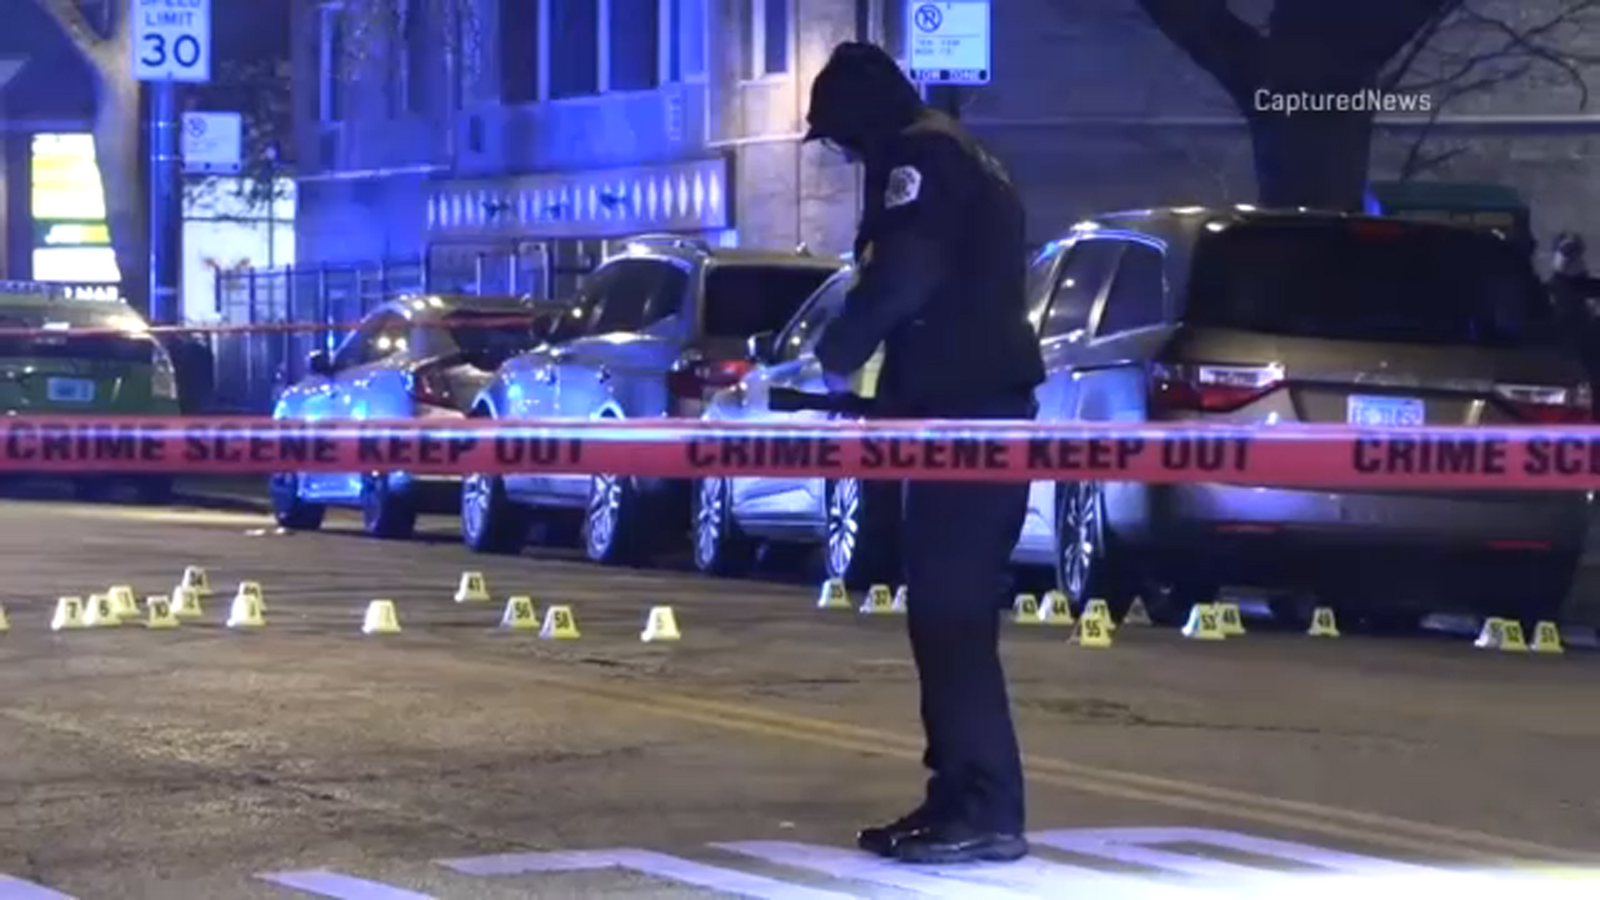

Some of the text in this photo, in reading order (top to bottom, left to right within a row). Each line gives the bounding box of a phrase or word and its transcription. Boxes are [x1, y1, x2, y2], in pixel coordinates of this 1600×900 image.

[146, 11, 193, 26] LIMIT
[142, 33, 201, 68] 30
[5, 422, 587, 466] CRIME SCENE KEEP OUT
[686, 432, 1250, 471] CRIME SCENE KEEP OUT
[1353, 435, 1508, 475] CRIME
